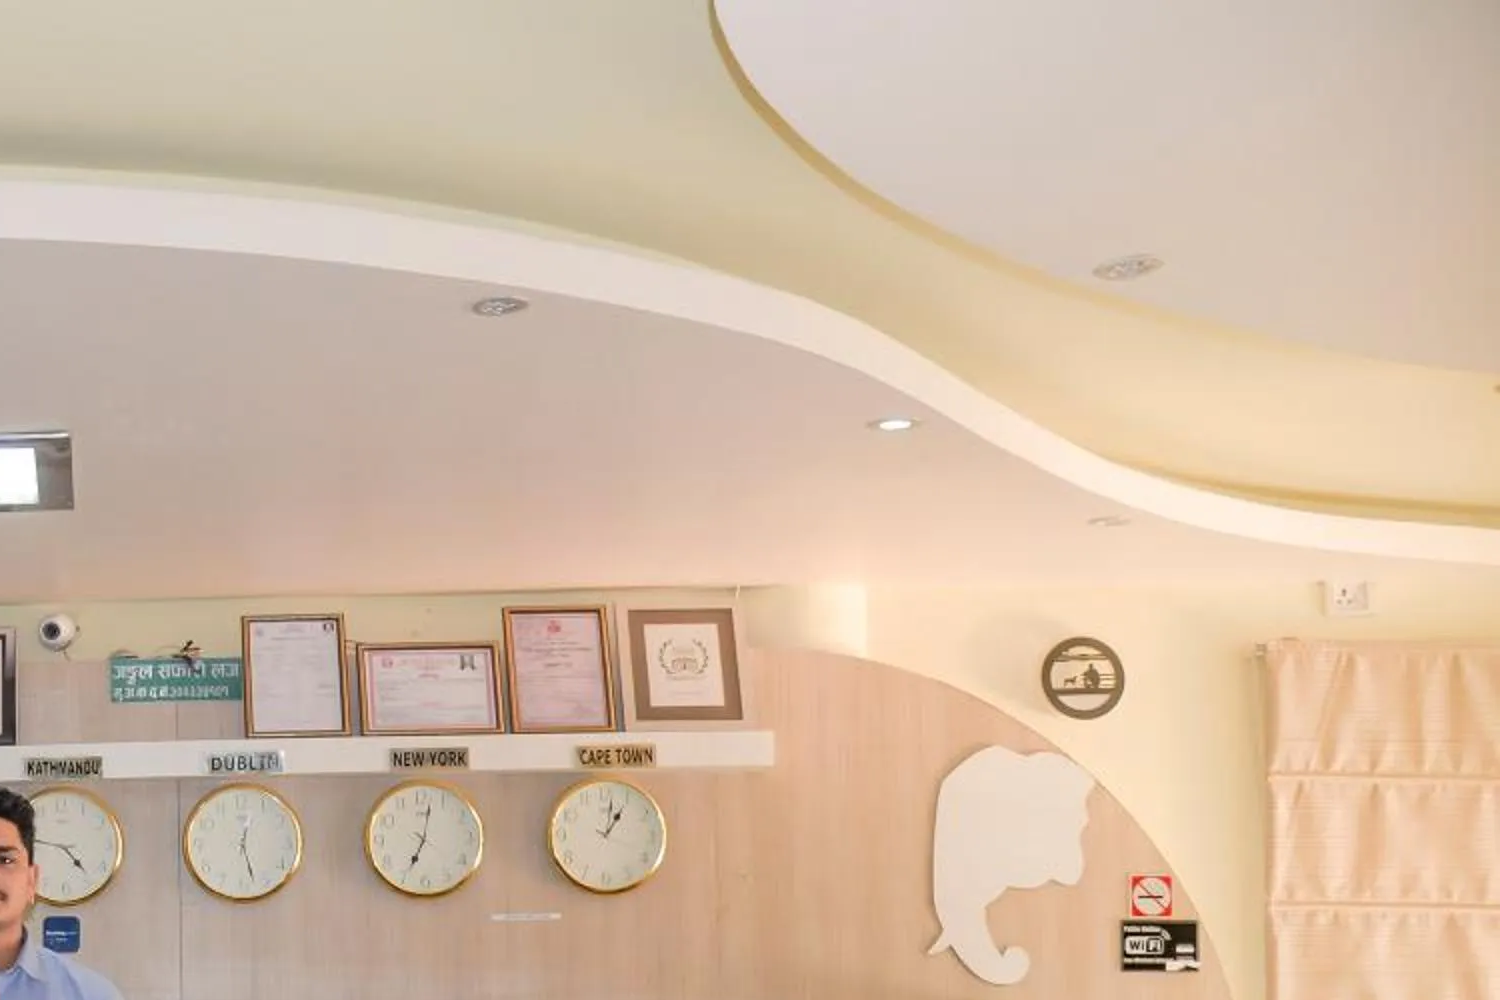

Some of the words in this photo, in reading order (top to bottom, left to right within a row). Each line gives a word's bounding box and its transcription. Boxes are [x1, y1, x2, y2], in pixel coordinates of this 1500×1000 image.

[211, 754, 279, 771] DUBLIN
[393, 751, 423, 767] NEW
[428, 751, 467, 766] YORK
[579, 749, 610, 765] CAPE
[616, 748, 654, 763] TOWN
